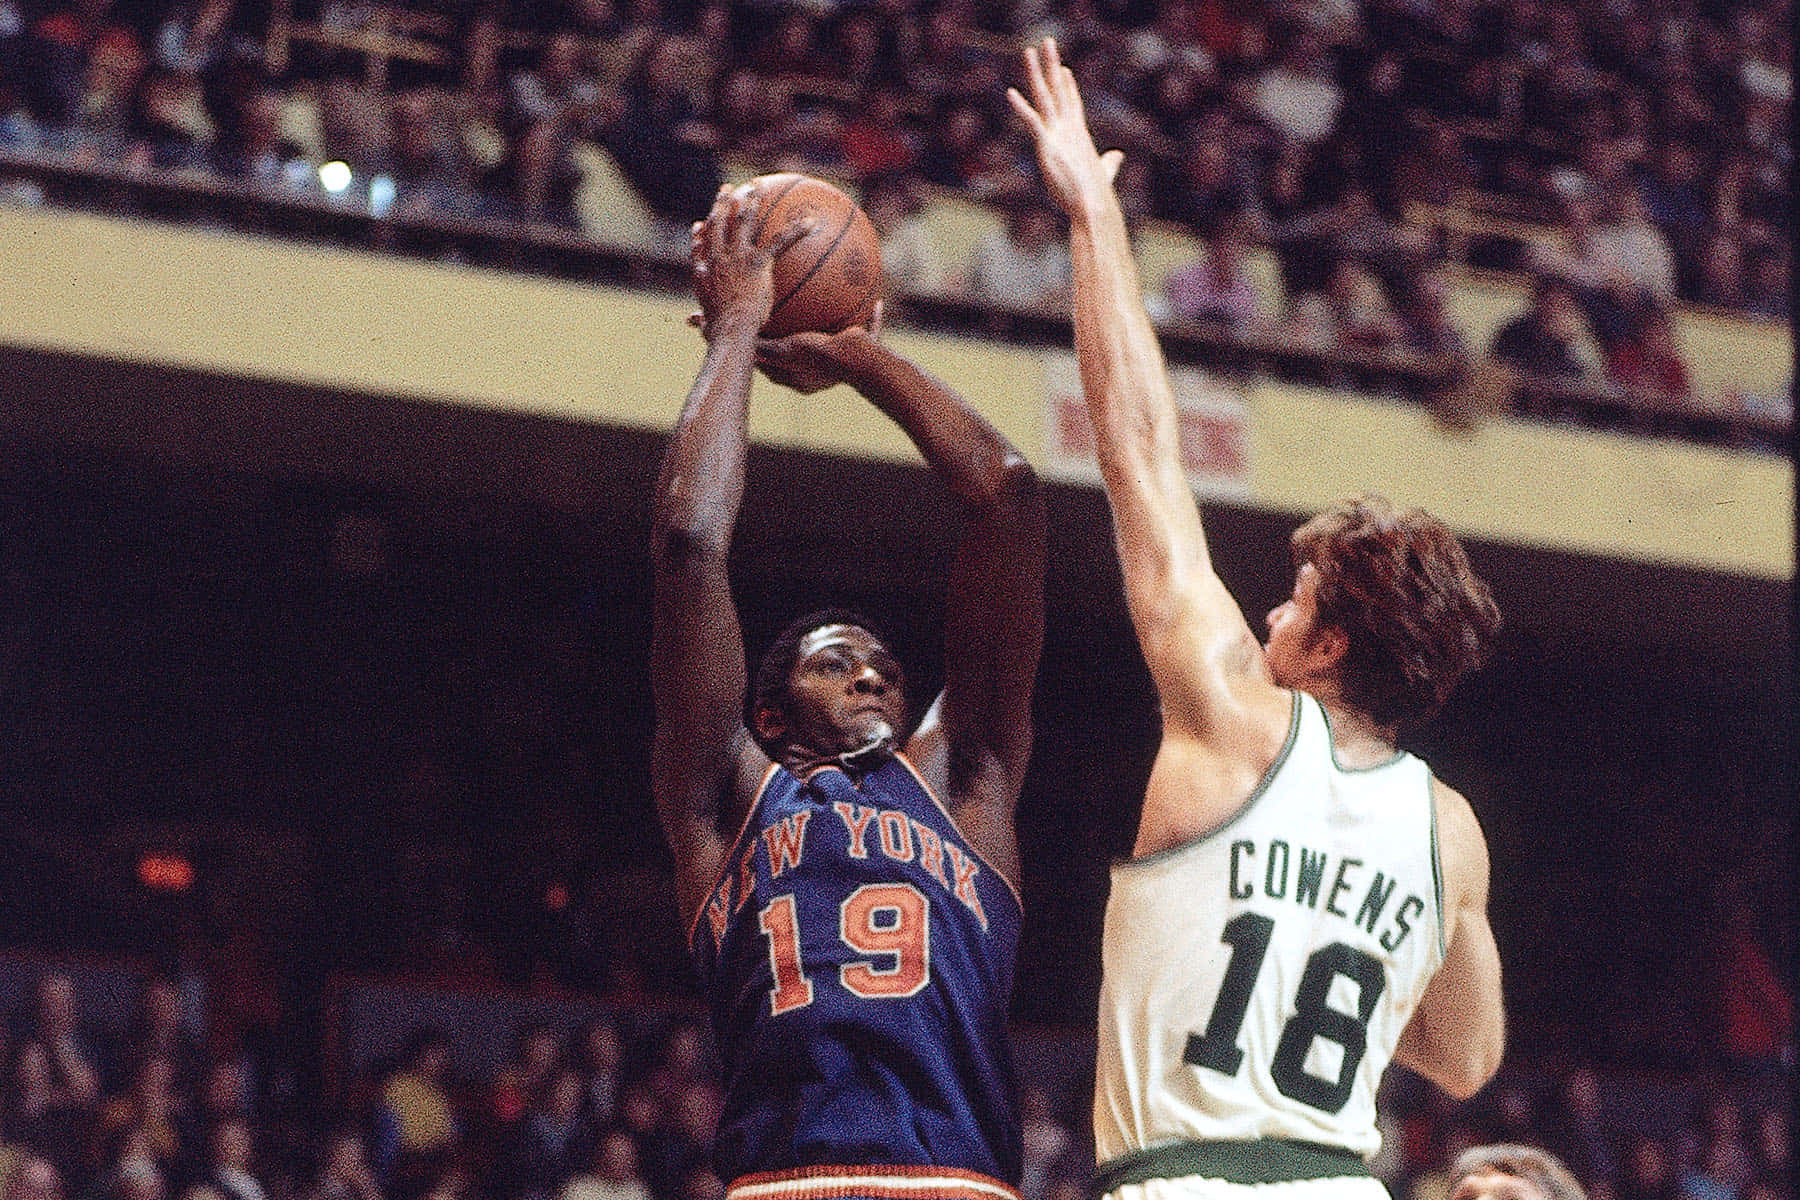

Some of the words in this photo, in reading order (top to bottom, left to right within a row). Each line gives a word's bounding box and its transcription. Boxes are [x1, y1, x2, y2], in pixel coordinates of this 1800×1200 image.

[833, 801, 988, 931] YORK
[1229, 839, 1425, 953] COWENS
[757, 882, 930, 1017] 19
[1182, 910, 1387, 1116] 18
